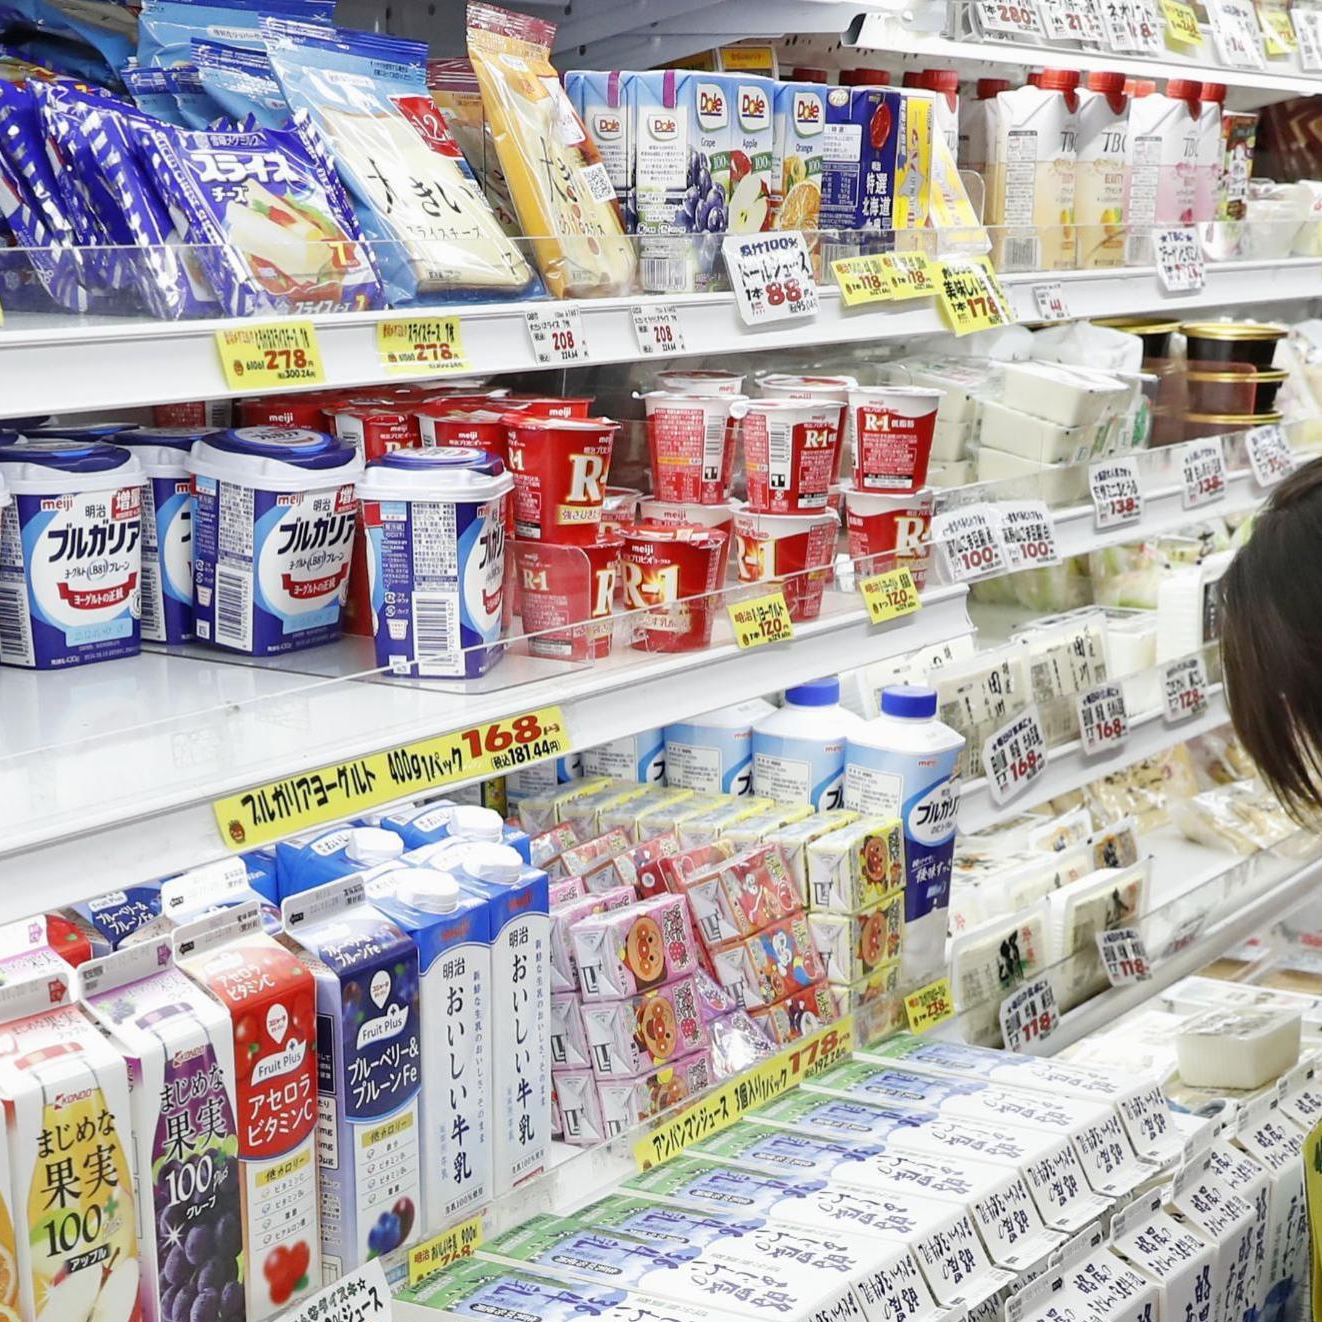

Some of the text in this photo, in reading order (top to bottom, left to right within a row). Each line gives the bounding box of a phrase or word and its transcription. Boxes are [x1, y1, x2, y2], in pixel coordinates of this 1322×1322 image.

[700, 90, 724, 114] Dole
[796, 100, 821, 121] Dole
[189, 152, 301, 184] スライス
[268, 412, 295, 427] meiji
[40, 496, 74, 512] meiji
[47, 522, 141, 562] ブルガリア
[279, 512, 356, 550] ブルガリア
[623, 561, 680, 610] R-1
[442, 956, 466, 980] 明治
[348, 1037, 419, 1082] ブルーベリー&
[511, 953, 535, 1147] おいしい牛乳
[160, 1064, 224, 1113] まじめな
[249, 1074, 311, 1119] アセロラ
[352, 1066, 419, 1110] プルーンFe
[446, 985, 474, 1186] おいしい牛乳
[248, 1098, 314, 1148] ビタミンC
[69, 1245, 108, 1272] アップル
